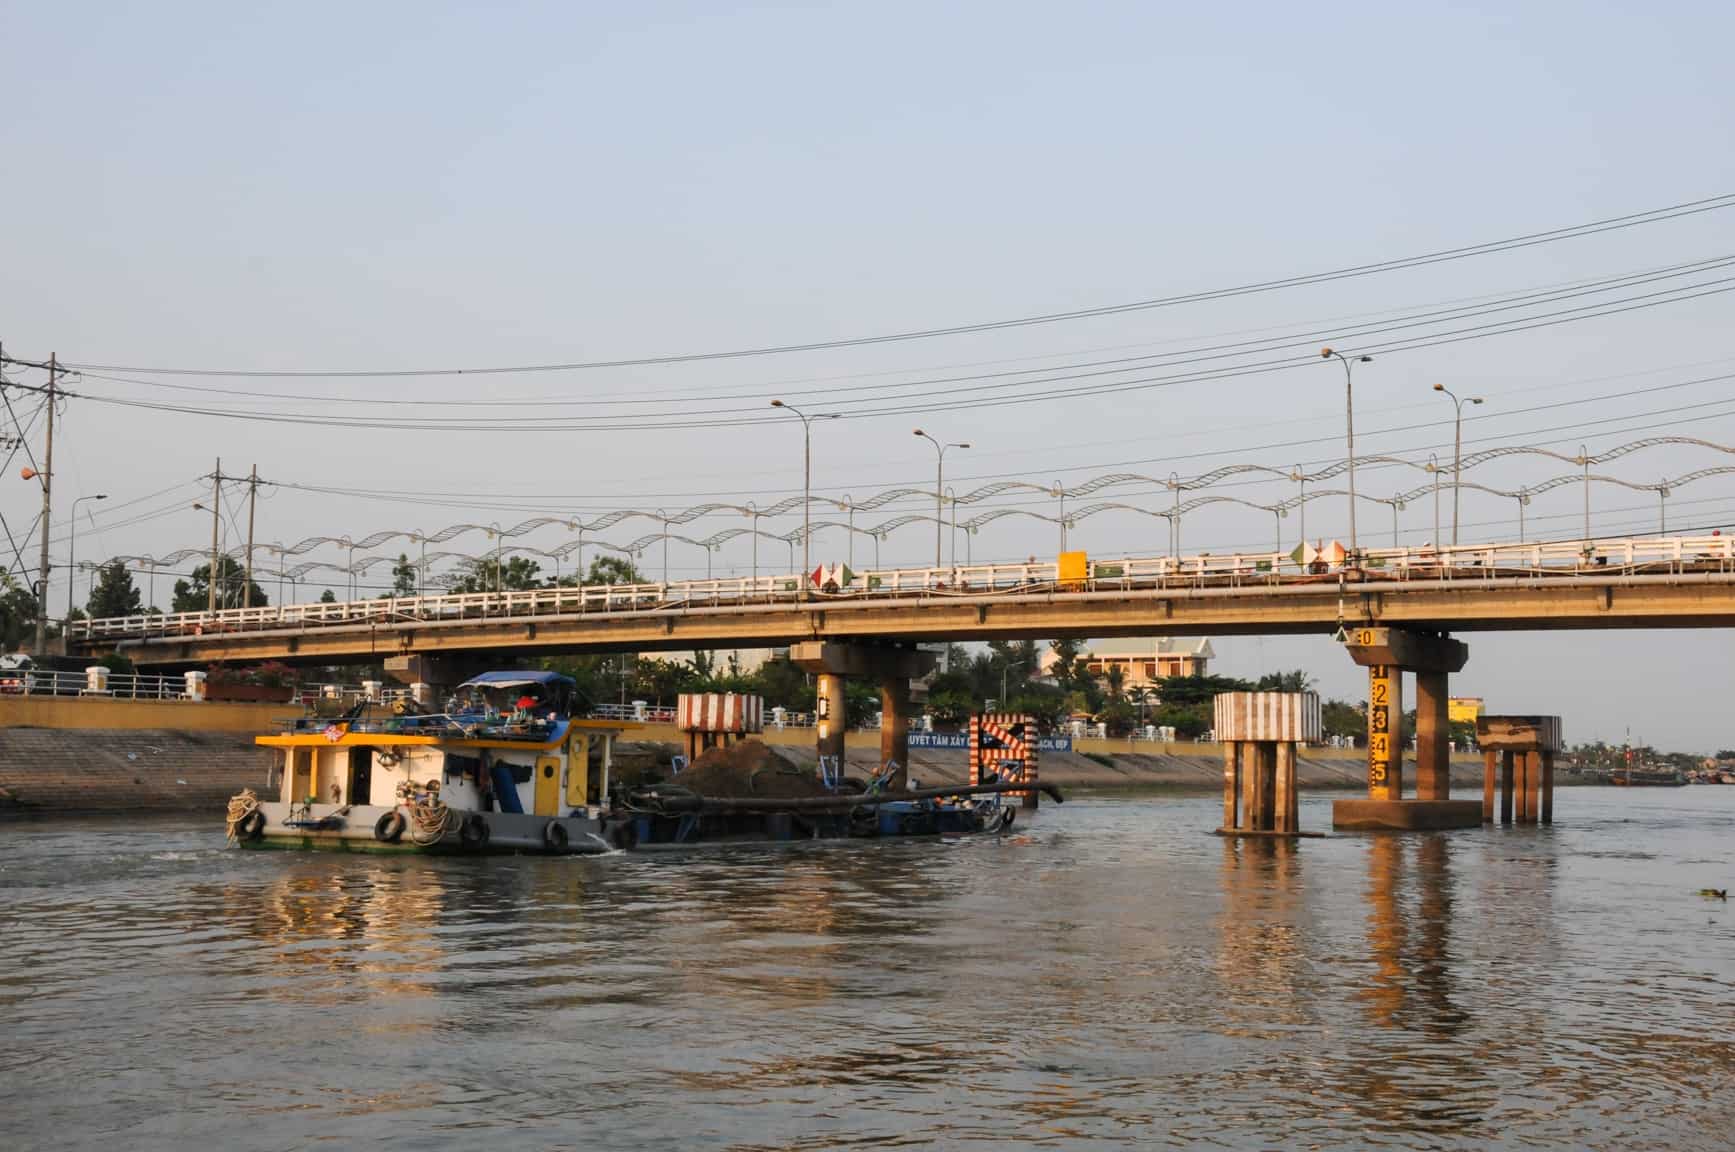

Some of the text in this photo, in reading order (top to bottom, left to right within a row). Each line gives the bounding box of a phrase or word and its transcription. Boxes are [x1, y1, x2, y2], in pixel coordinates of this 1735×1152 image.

[1363, 631, 1371, 645] 0
[1376, 685, 1386, 703] 2
[1376, 711, 1387, 729] 3
[1376, 739, 1386, 753] 4
[1375, 763, 1387, 781] 5
